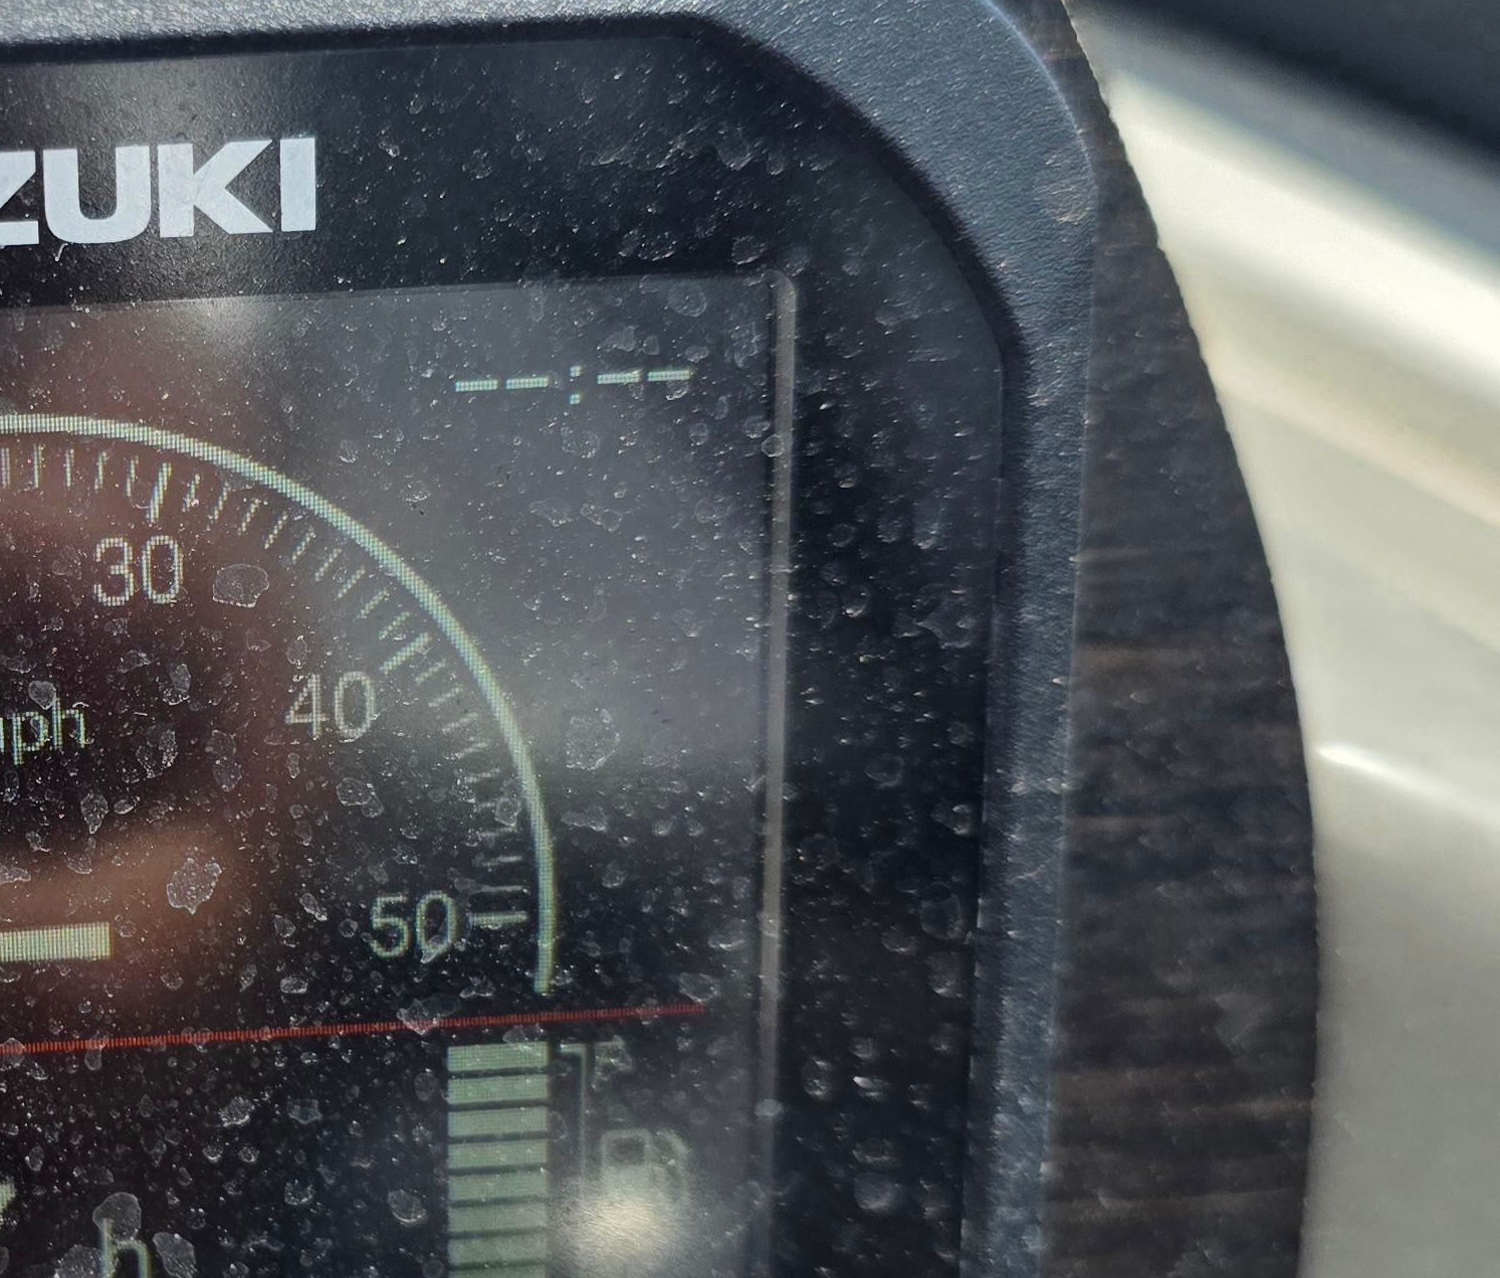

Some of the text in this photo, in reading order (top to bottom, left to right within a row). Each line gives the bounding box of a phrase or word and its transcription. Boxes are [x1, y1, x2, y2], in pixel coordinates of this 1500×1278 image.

[94, 536, 184, 607] 30
[285, 671, 376, 739] 40
[370, 891, 458, 959] 50
